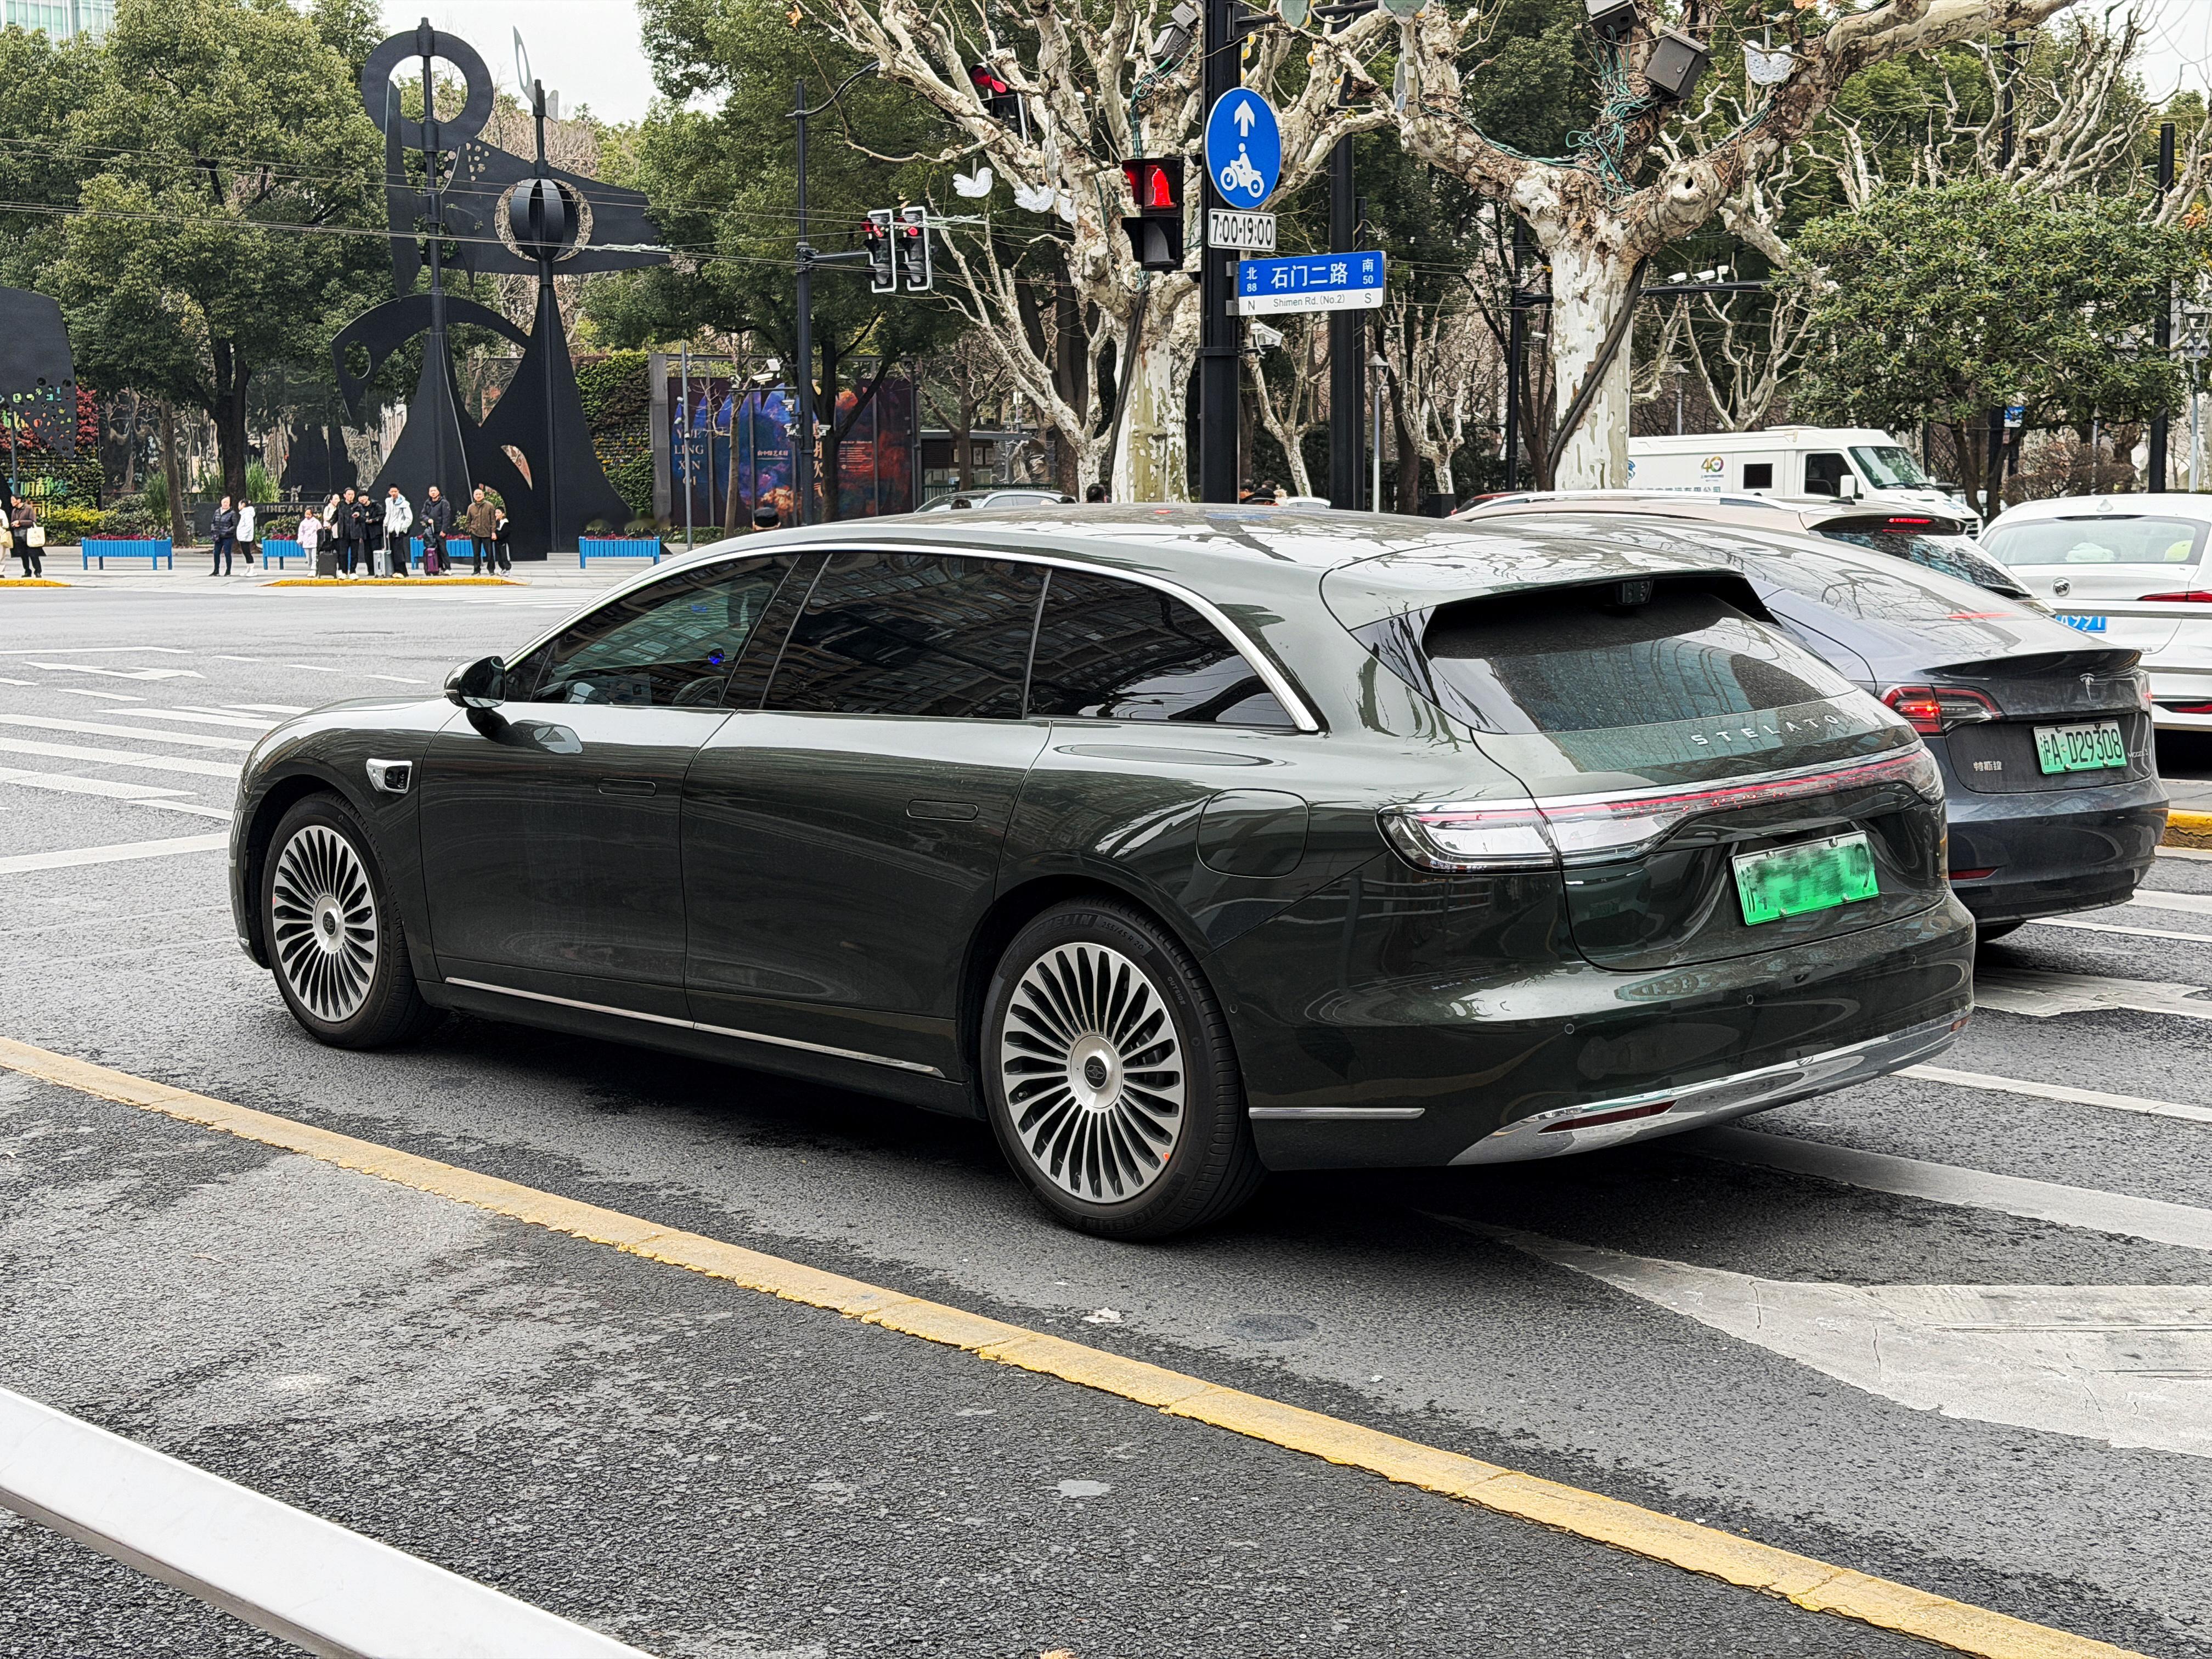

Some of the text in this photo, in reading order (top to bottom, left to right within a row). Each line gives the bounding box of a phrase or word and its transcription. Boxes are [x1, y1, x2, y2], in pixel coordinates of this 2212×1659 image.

[1212, 214, 1272, 246] 7:00-19:00
[1362, 258, 1374, 273] 南
[1246, 267, 1257, 280] 北
[1271, 262, 1348, 289] 石门二路
[1363, 275, 1374, 285] 50
[1246, 283, 1257, 292] 88
[1273, 297, 1302, 307] Shimen
[1364, 292, 1372, 303] S
[1248, 300, 1255, 311] N
[678, 461, 701, 470] XN
[1690, 715, 1839, 746] STELATO
[1101, 921, 1127, 937] 255/45
[1134, 940, 1144, 950] 20
[1167, 976, 1186, 1005] OUTSIDE
